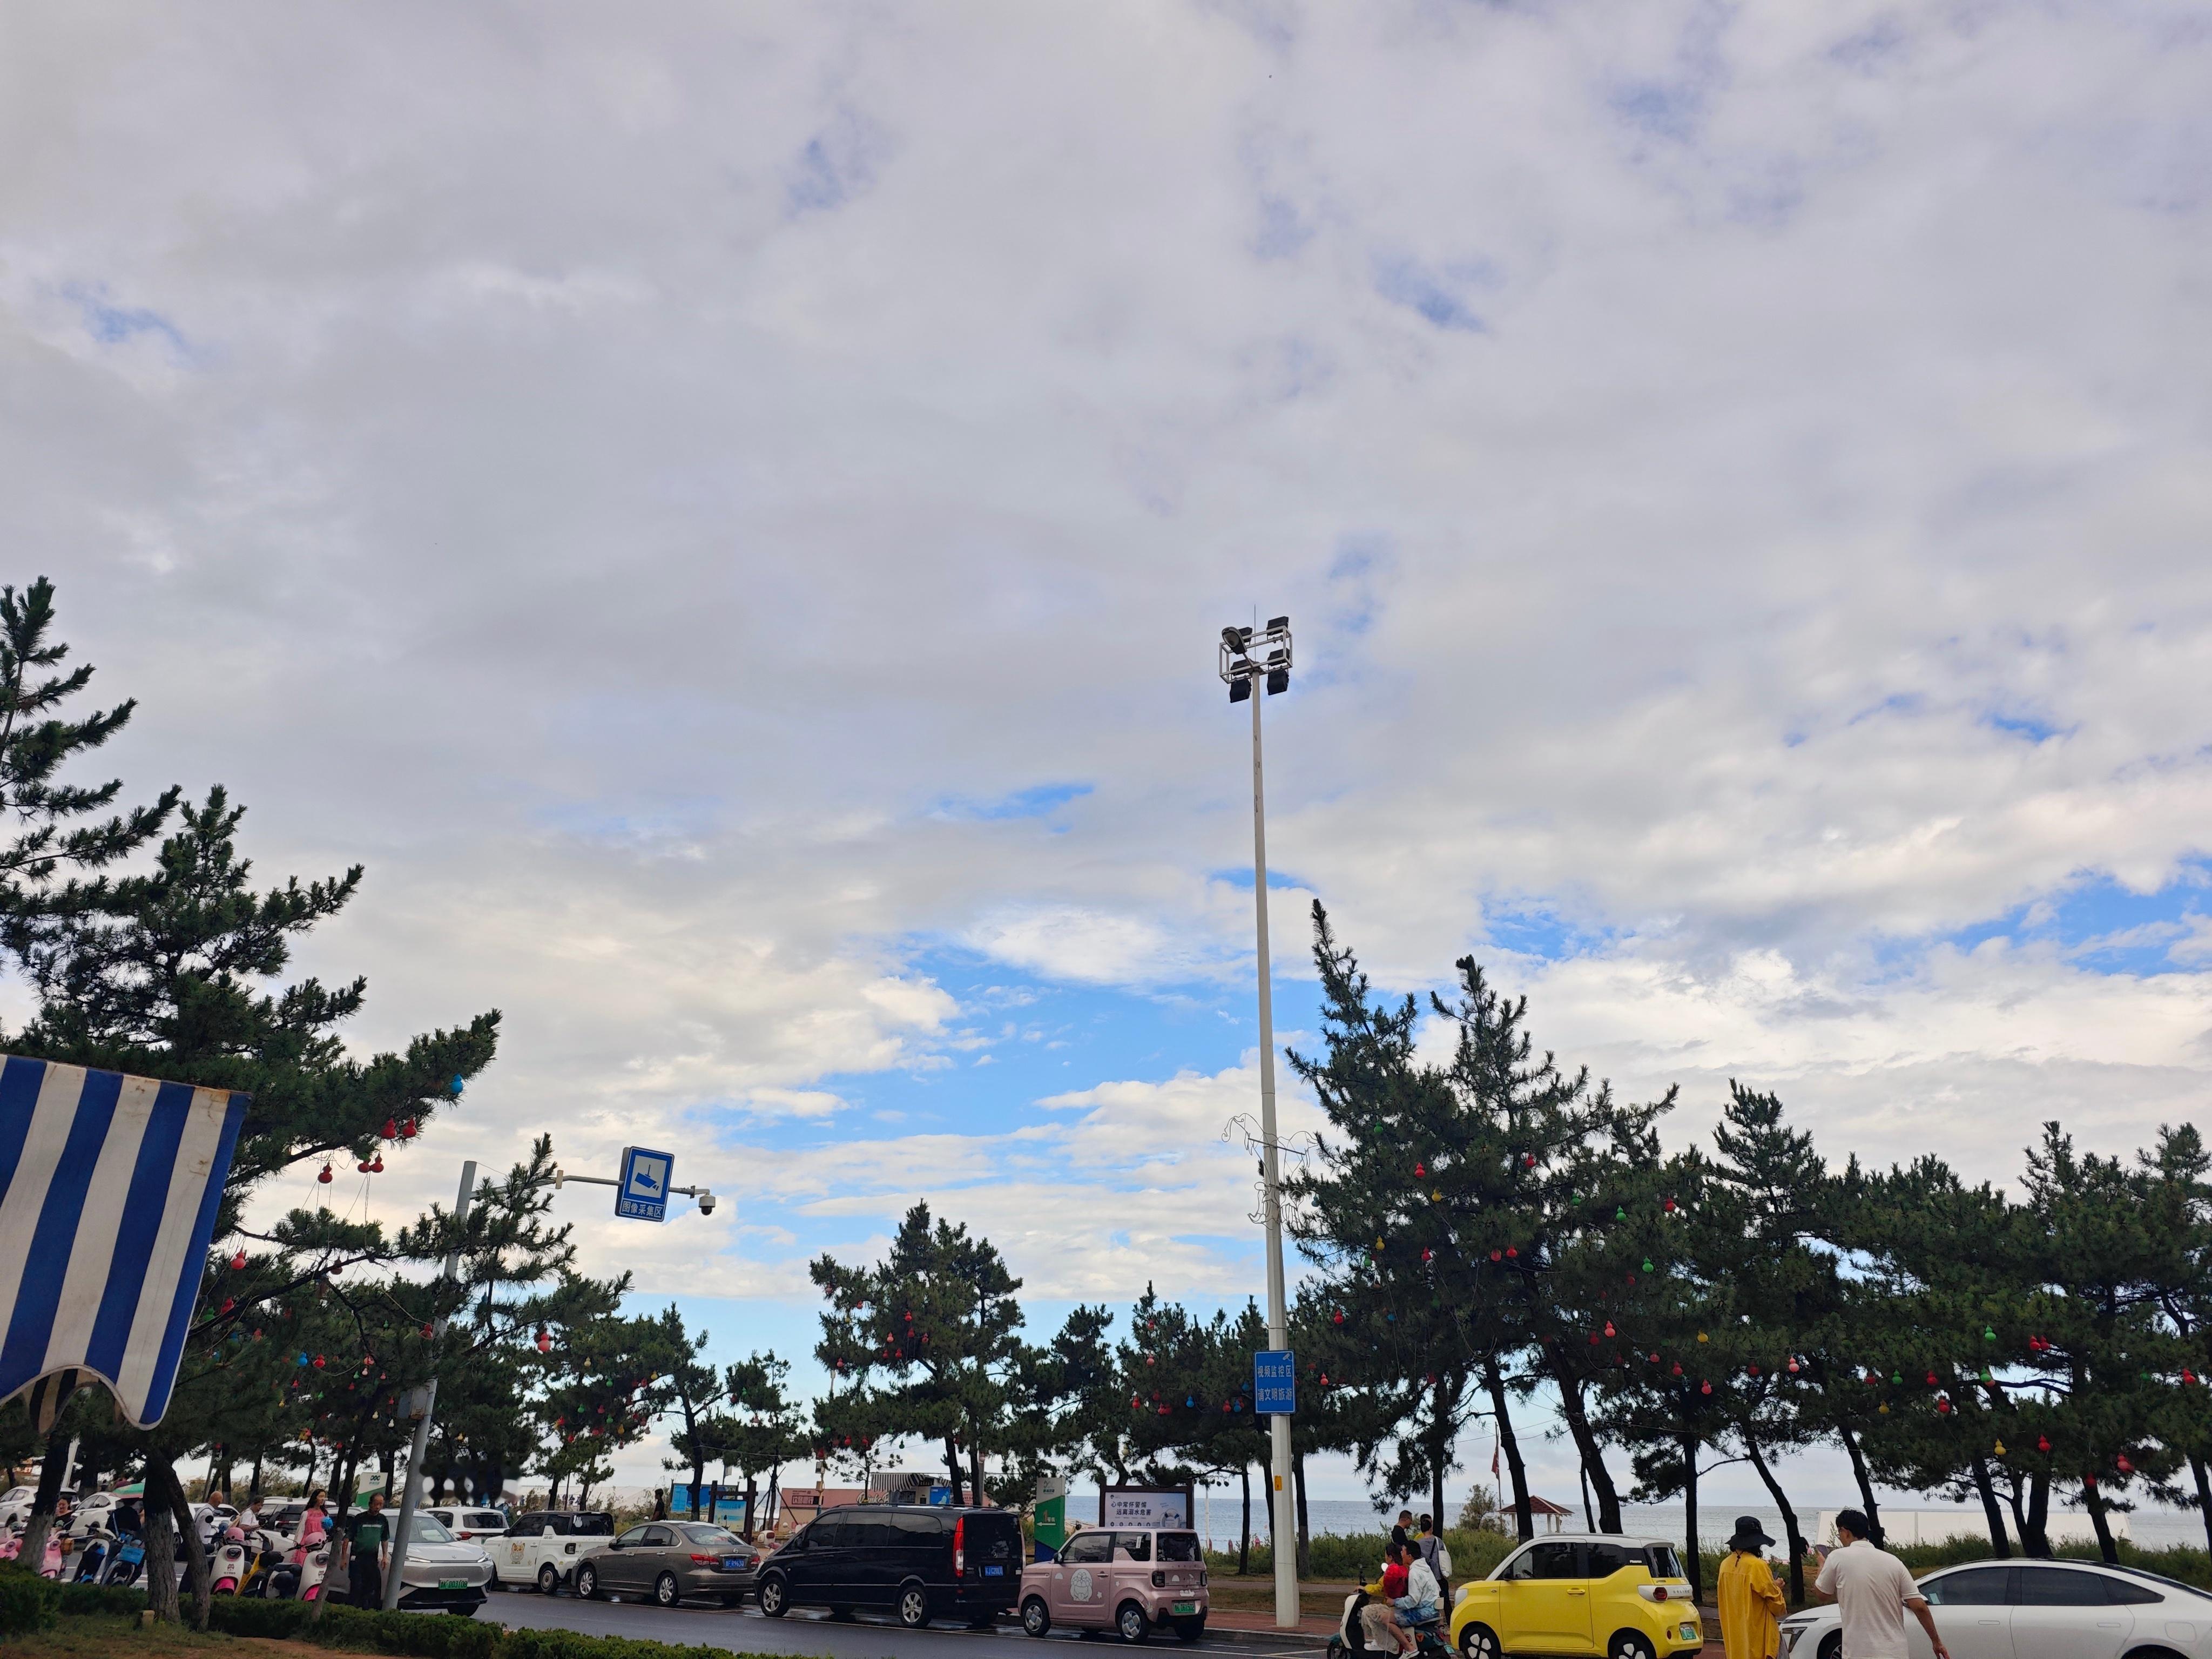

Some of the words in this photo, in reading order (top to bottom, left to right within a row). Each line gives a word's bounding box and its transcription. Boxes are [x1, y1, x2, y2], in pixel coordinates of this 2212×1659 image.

[622, 1201, 663, 1218] 图像采集区
[1257, 1365, 1292, 1378] 视频监控区
[1258, 1387, 1292, 1401] 请文明旅游
